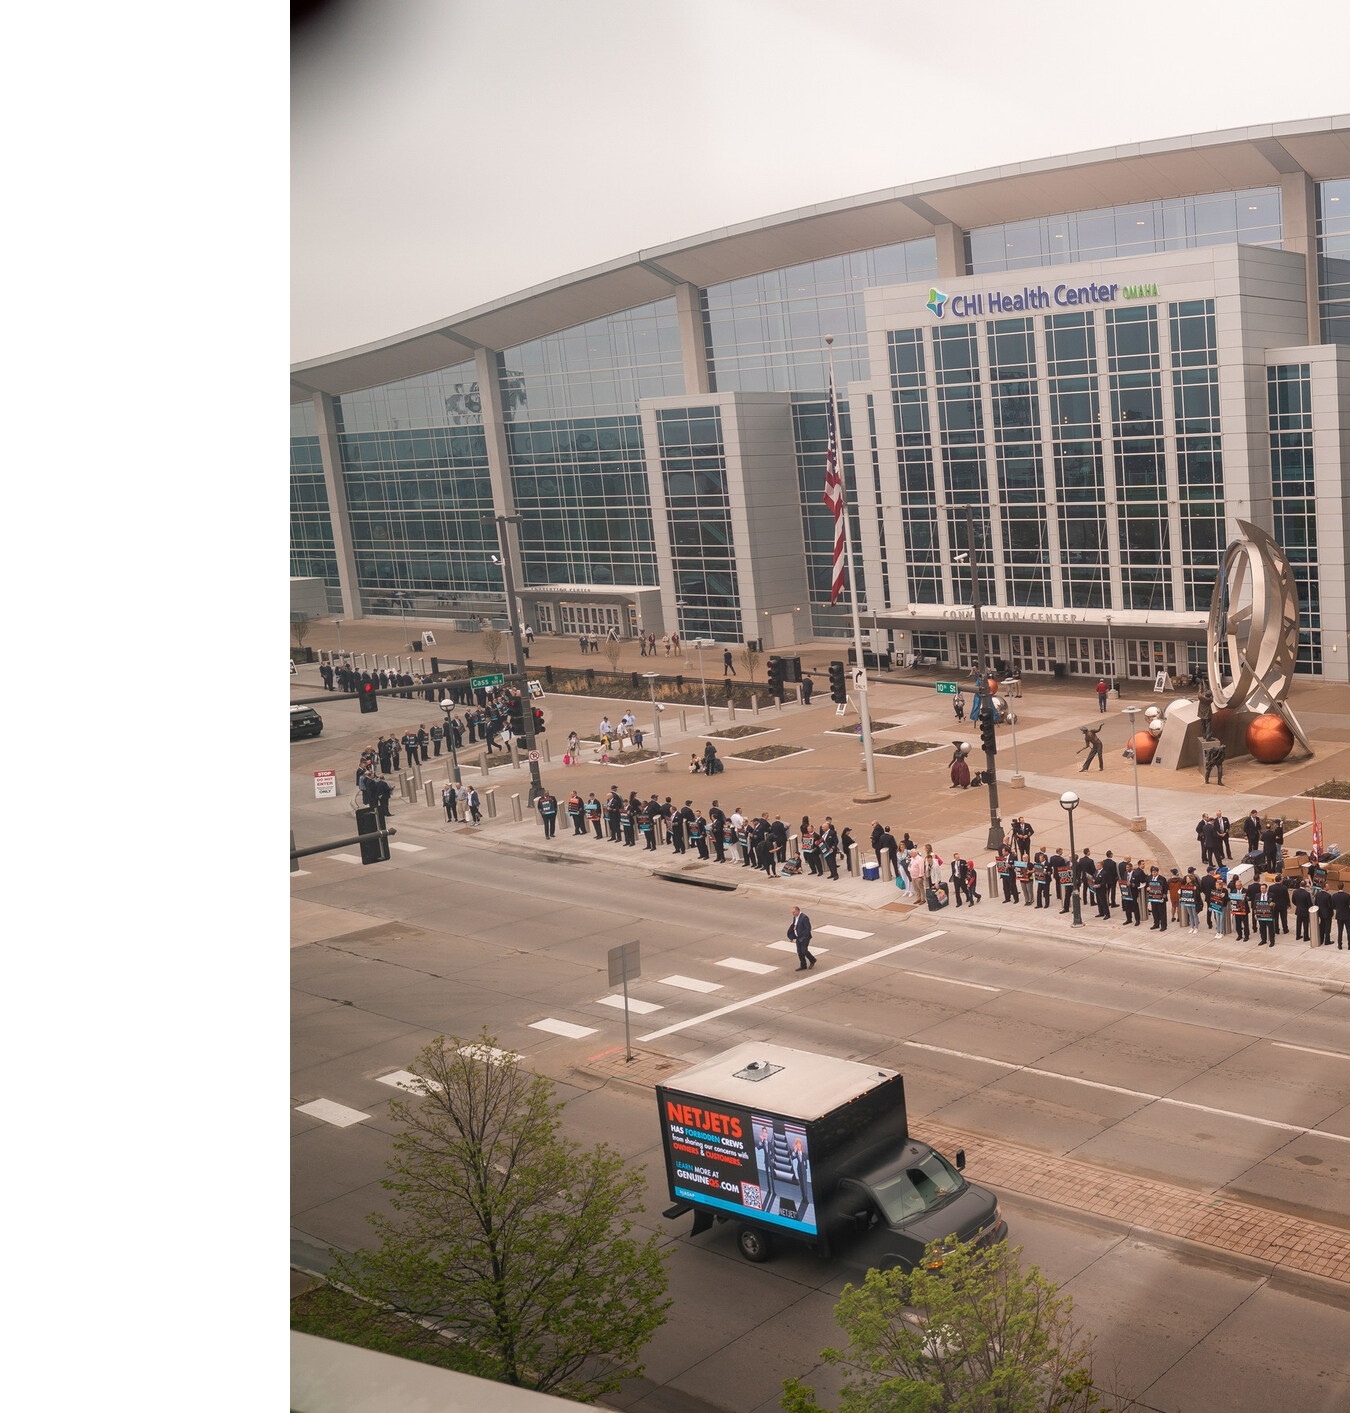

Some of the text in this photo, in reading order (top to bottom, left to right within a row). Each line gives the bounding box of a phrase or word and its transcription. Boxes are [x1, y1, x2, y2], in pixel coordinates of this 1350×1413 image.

[952, 282, 1159, 317] CHI Health Center OMAHA
[943, 610, 1077, 623] CONVNTION CENTER
[473, 679, 489, 687] Cass
[949, 684, 956, 692] St
[667, 1101, 743, 1138] NETJETS
[670, 1124, 744, 1150] HAS FORBIDDEN CREWS
[672, 1133, 684, 1142] from
[685, 1137, 704, 1149] sharing
[714, 1146, 737, 1157] concerns
[737, 1151, 749, 1160] with
[673, 1142, 743, 1166] OWNERS & CUSTOMERS.
[675, 1161, 719, 1179] LEARN MORE AT
[676, 1169, 740, 1193] GENUINEQS.COM
